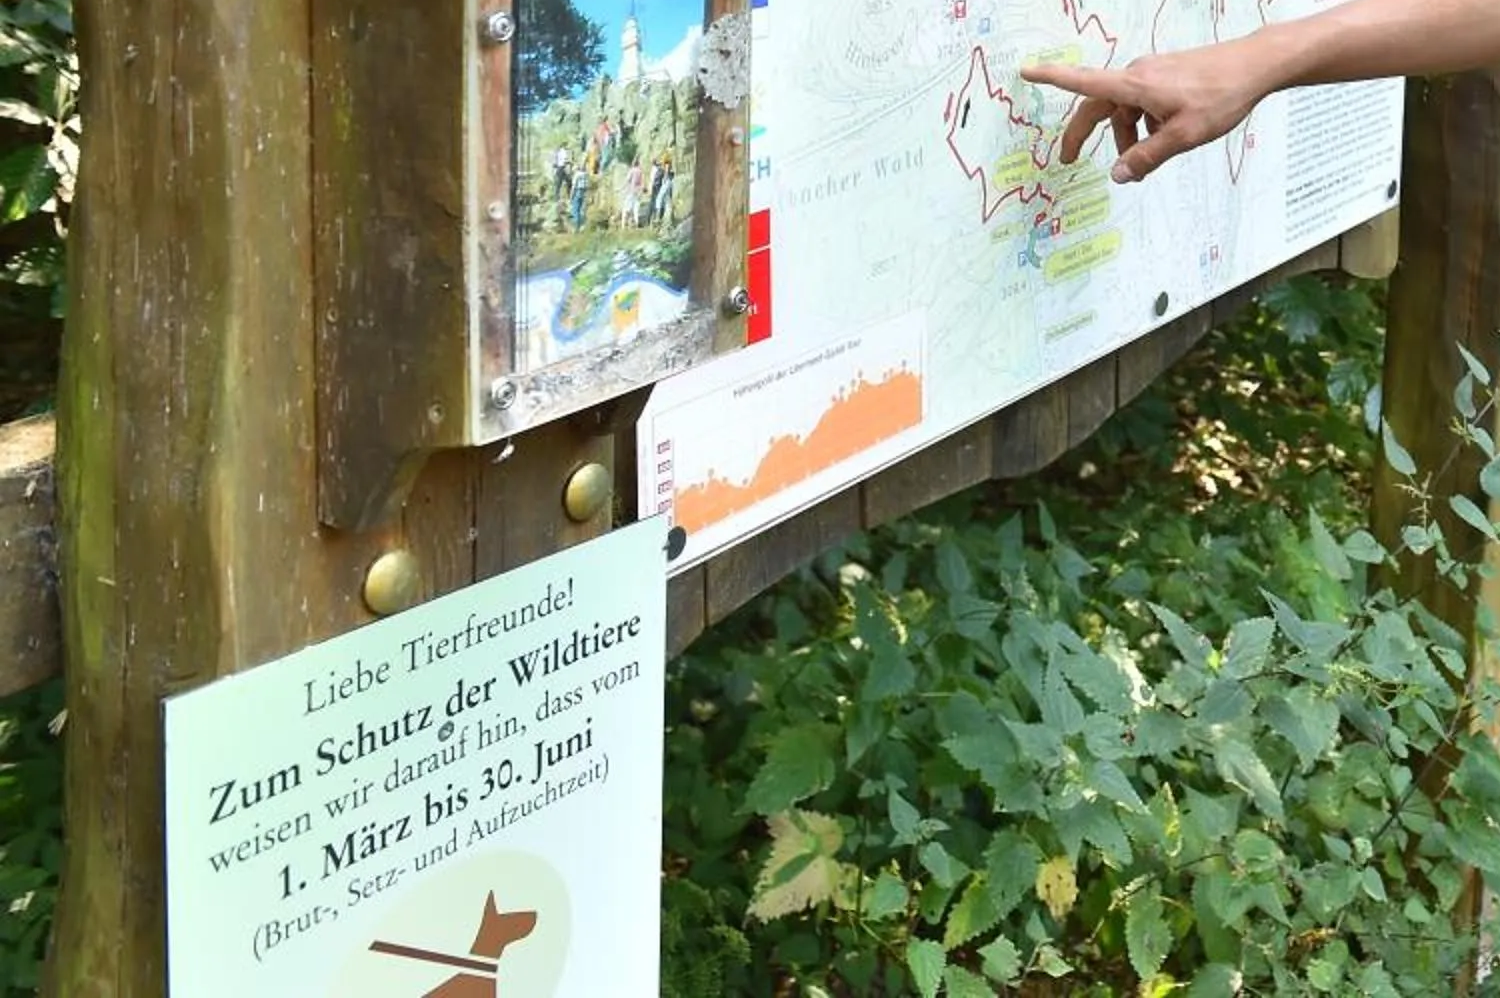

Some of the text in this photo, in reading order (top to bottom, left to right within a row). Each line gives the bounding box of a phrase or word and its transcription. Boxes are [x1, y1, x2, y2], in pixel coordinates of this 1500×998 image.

[208, 611, 642, 825] Zum Schutz der Wildtiere
[302, 578, 575, 716] Liebe Tierfreunde!
[208, 659, 641, 874] weisen wir darauf hin, dass vom
[251, 753, 610, 963] (Brut-, Setz- und Aufzuchtzeit)
[279, 718, 594, 901] 1. März bis 30. Juni
